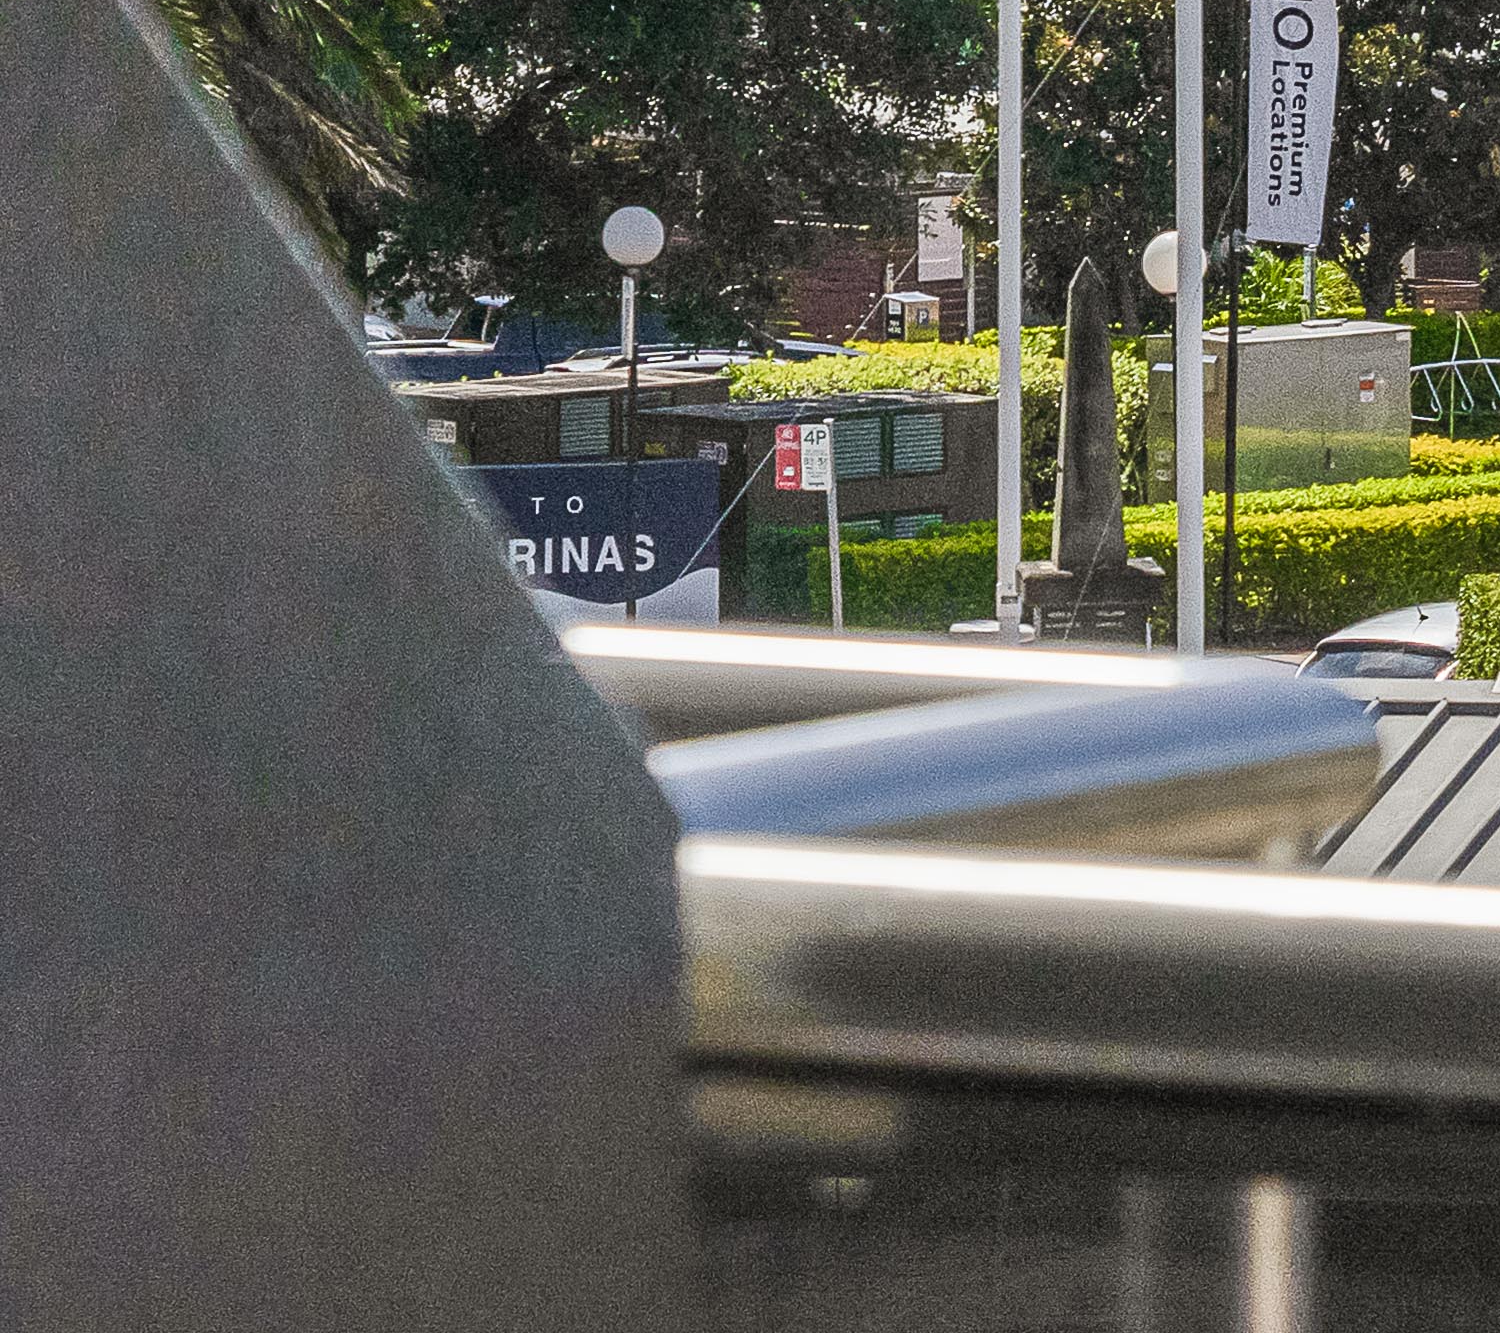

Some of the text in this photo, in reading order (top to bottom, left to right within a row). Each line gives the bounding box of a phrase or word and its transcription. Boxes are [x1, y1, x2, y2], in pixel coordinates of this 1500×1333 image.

[1268, 60, 1291, 207] Locations
[1288, 62, 1313, 197] Premium
[803, 430, 827, 446] 4P
[531, 495, 584, 515] TO
[508, 534, 656, 575] RINAS
